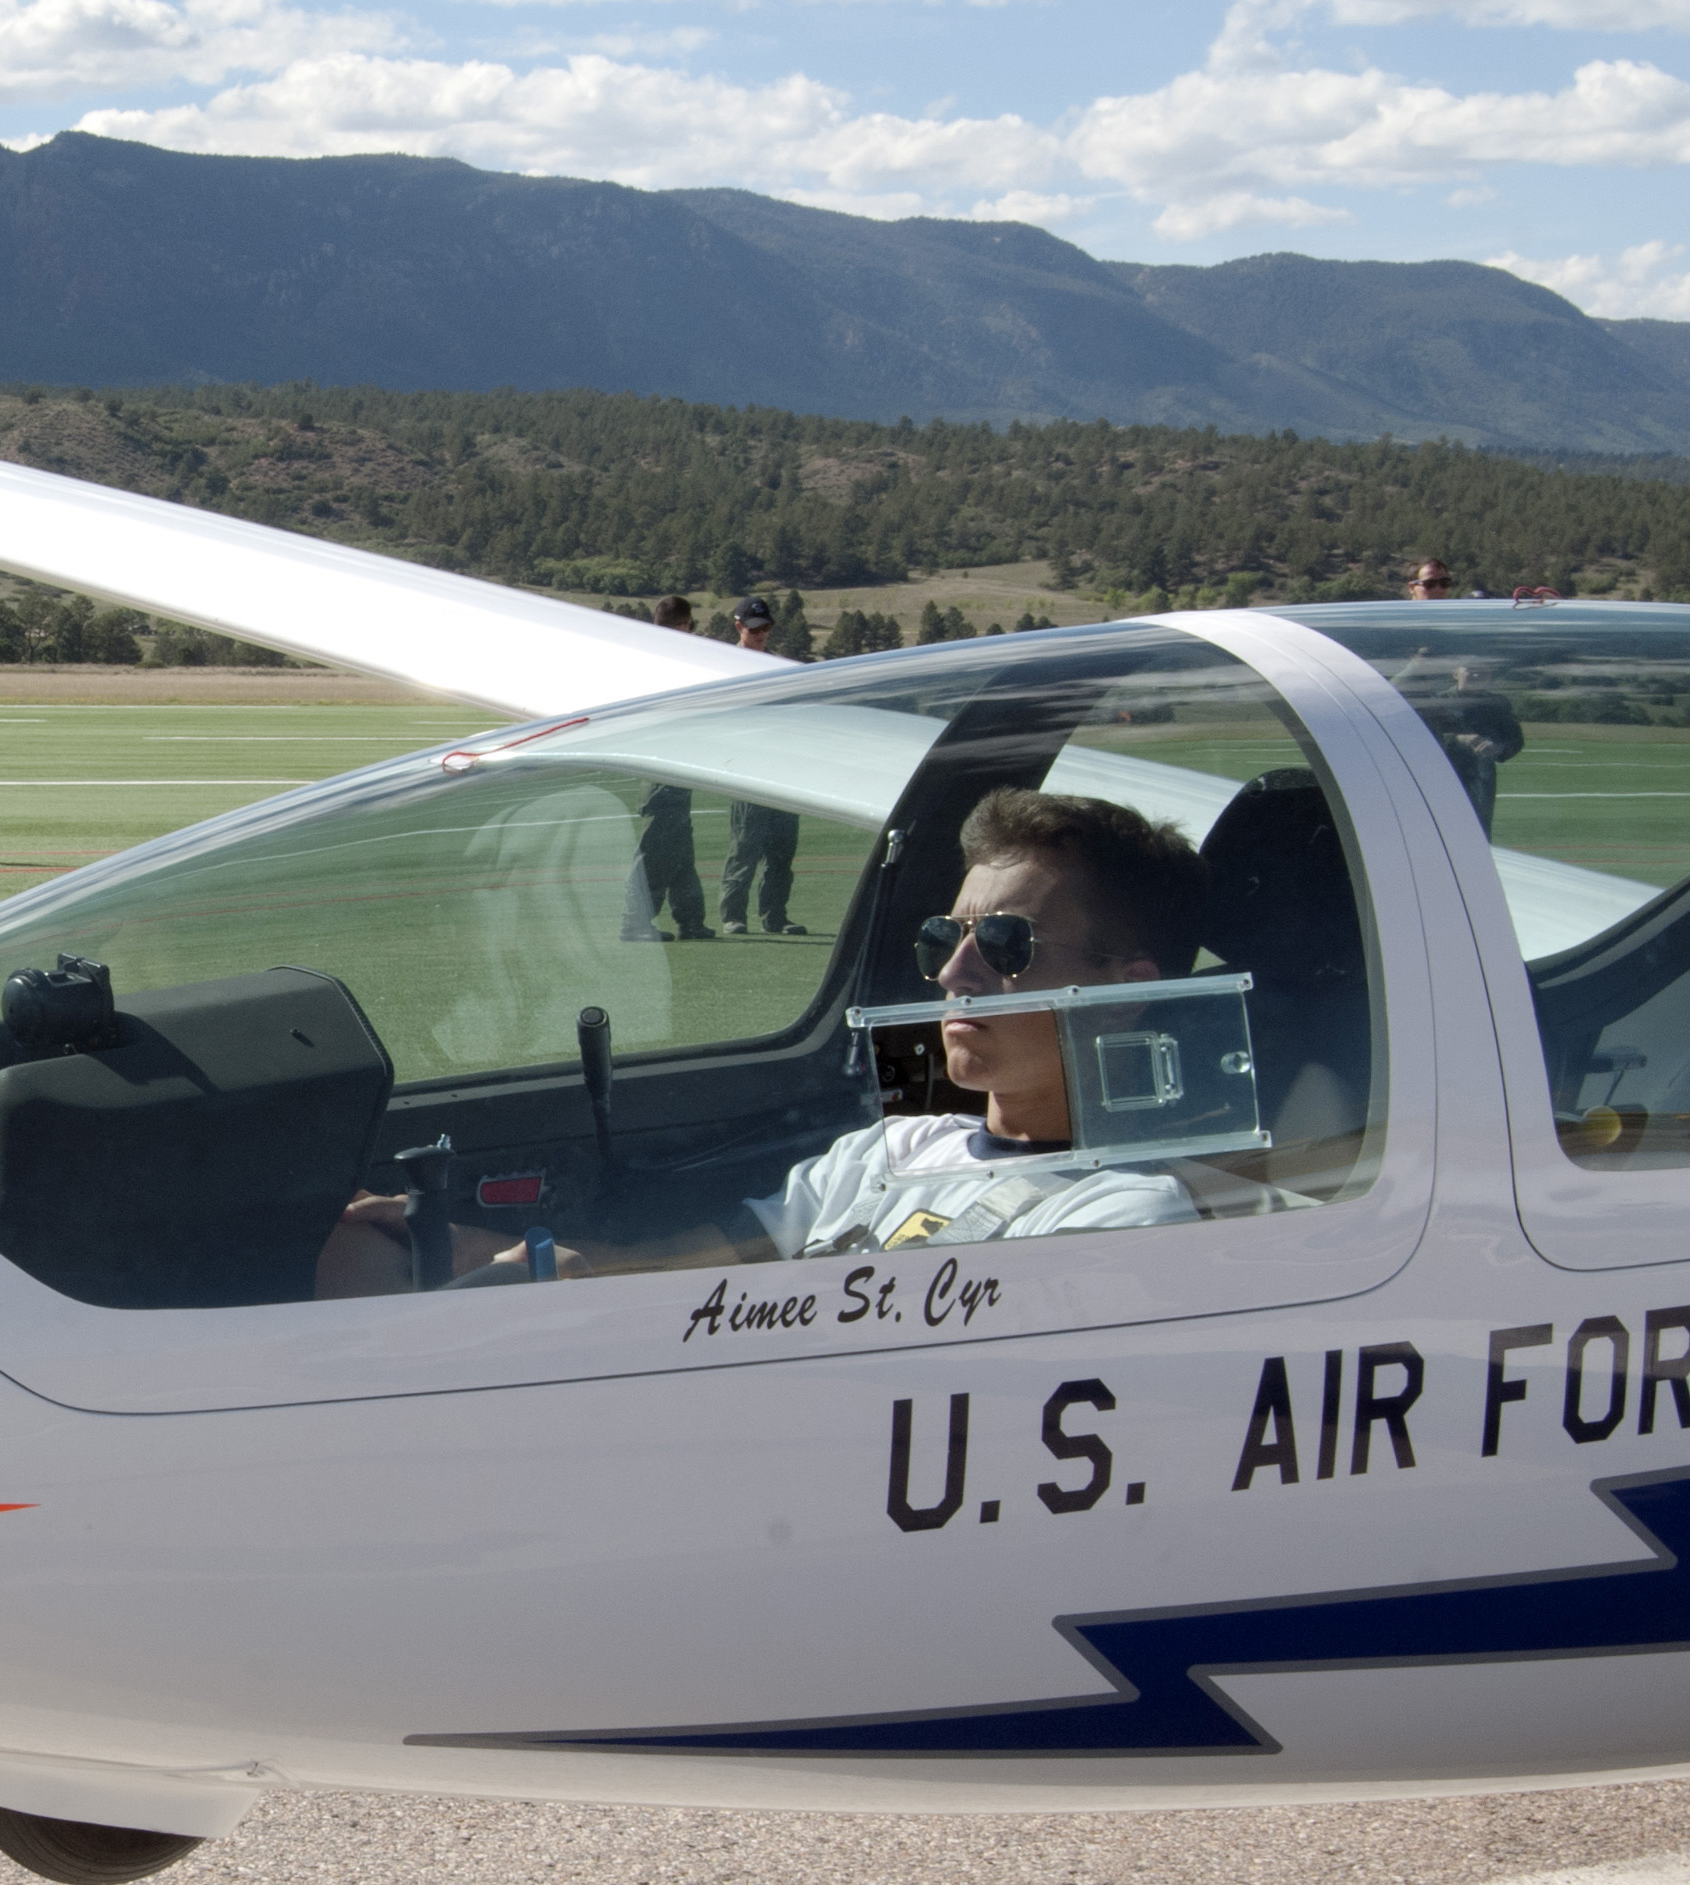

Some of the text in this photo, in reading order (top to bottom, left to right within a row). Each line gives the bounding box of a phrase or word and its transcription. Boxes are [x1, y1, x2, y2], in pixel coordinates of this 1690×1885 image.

[682, 1257, 1002, 1343] Aimee St. Cyr
[885, 1377, 1146, 1533] U.S.
[1230, 1340, 1425, 1492] AIR
